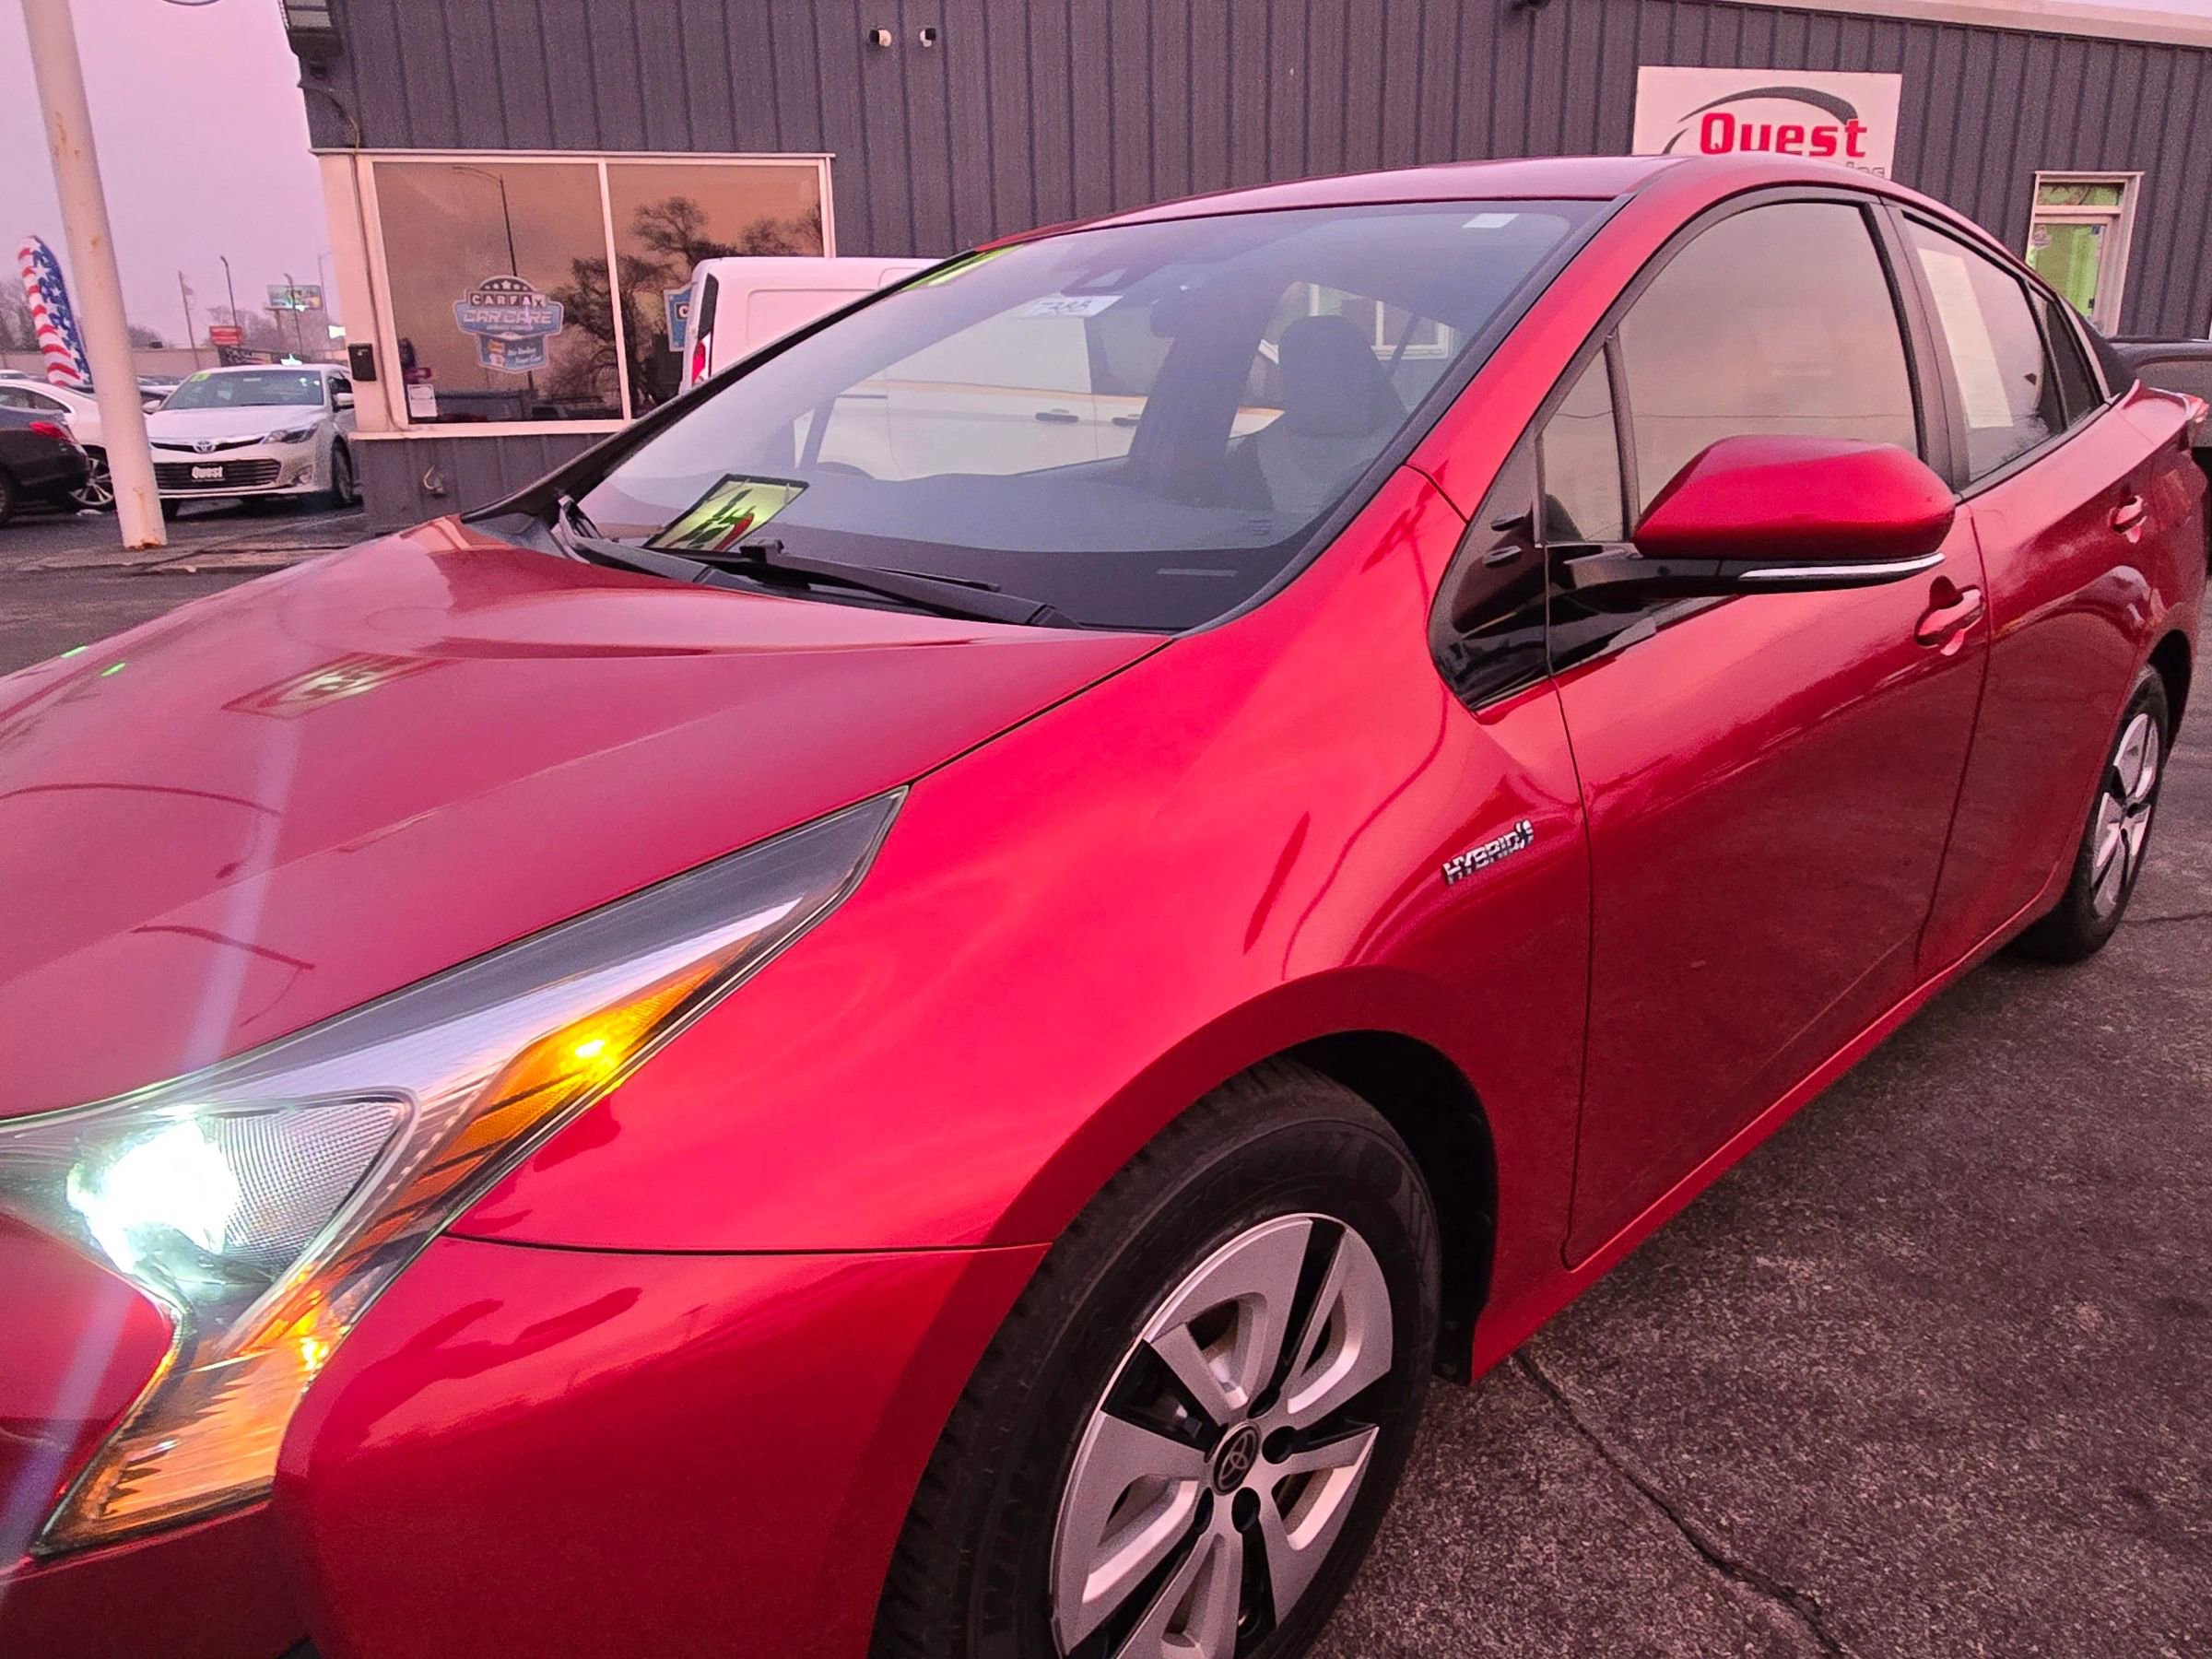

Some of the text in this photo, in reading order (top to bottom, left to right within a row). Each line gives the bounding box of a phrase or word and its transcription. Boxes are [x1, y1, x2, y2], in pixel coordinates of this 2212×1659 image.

[1700, 112, 1867, 158] Quest
[470, 294, 546, 308] CARFAX
[463, 309, 552, 324] CAR CARE
[1442, 830, 1526, 885] HYBRID
